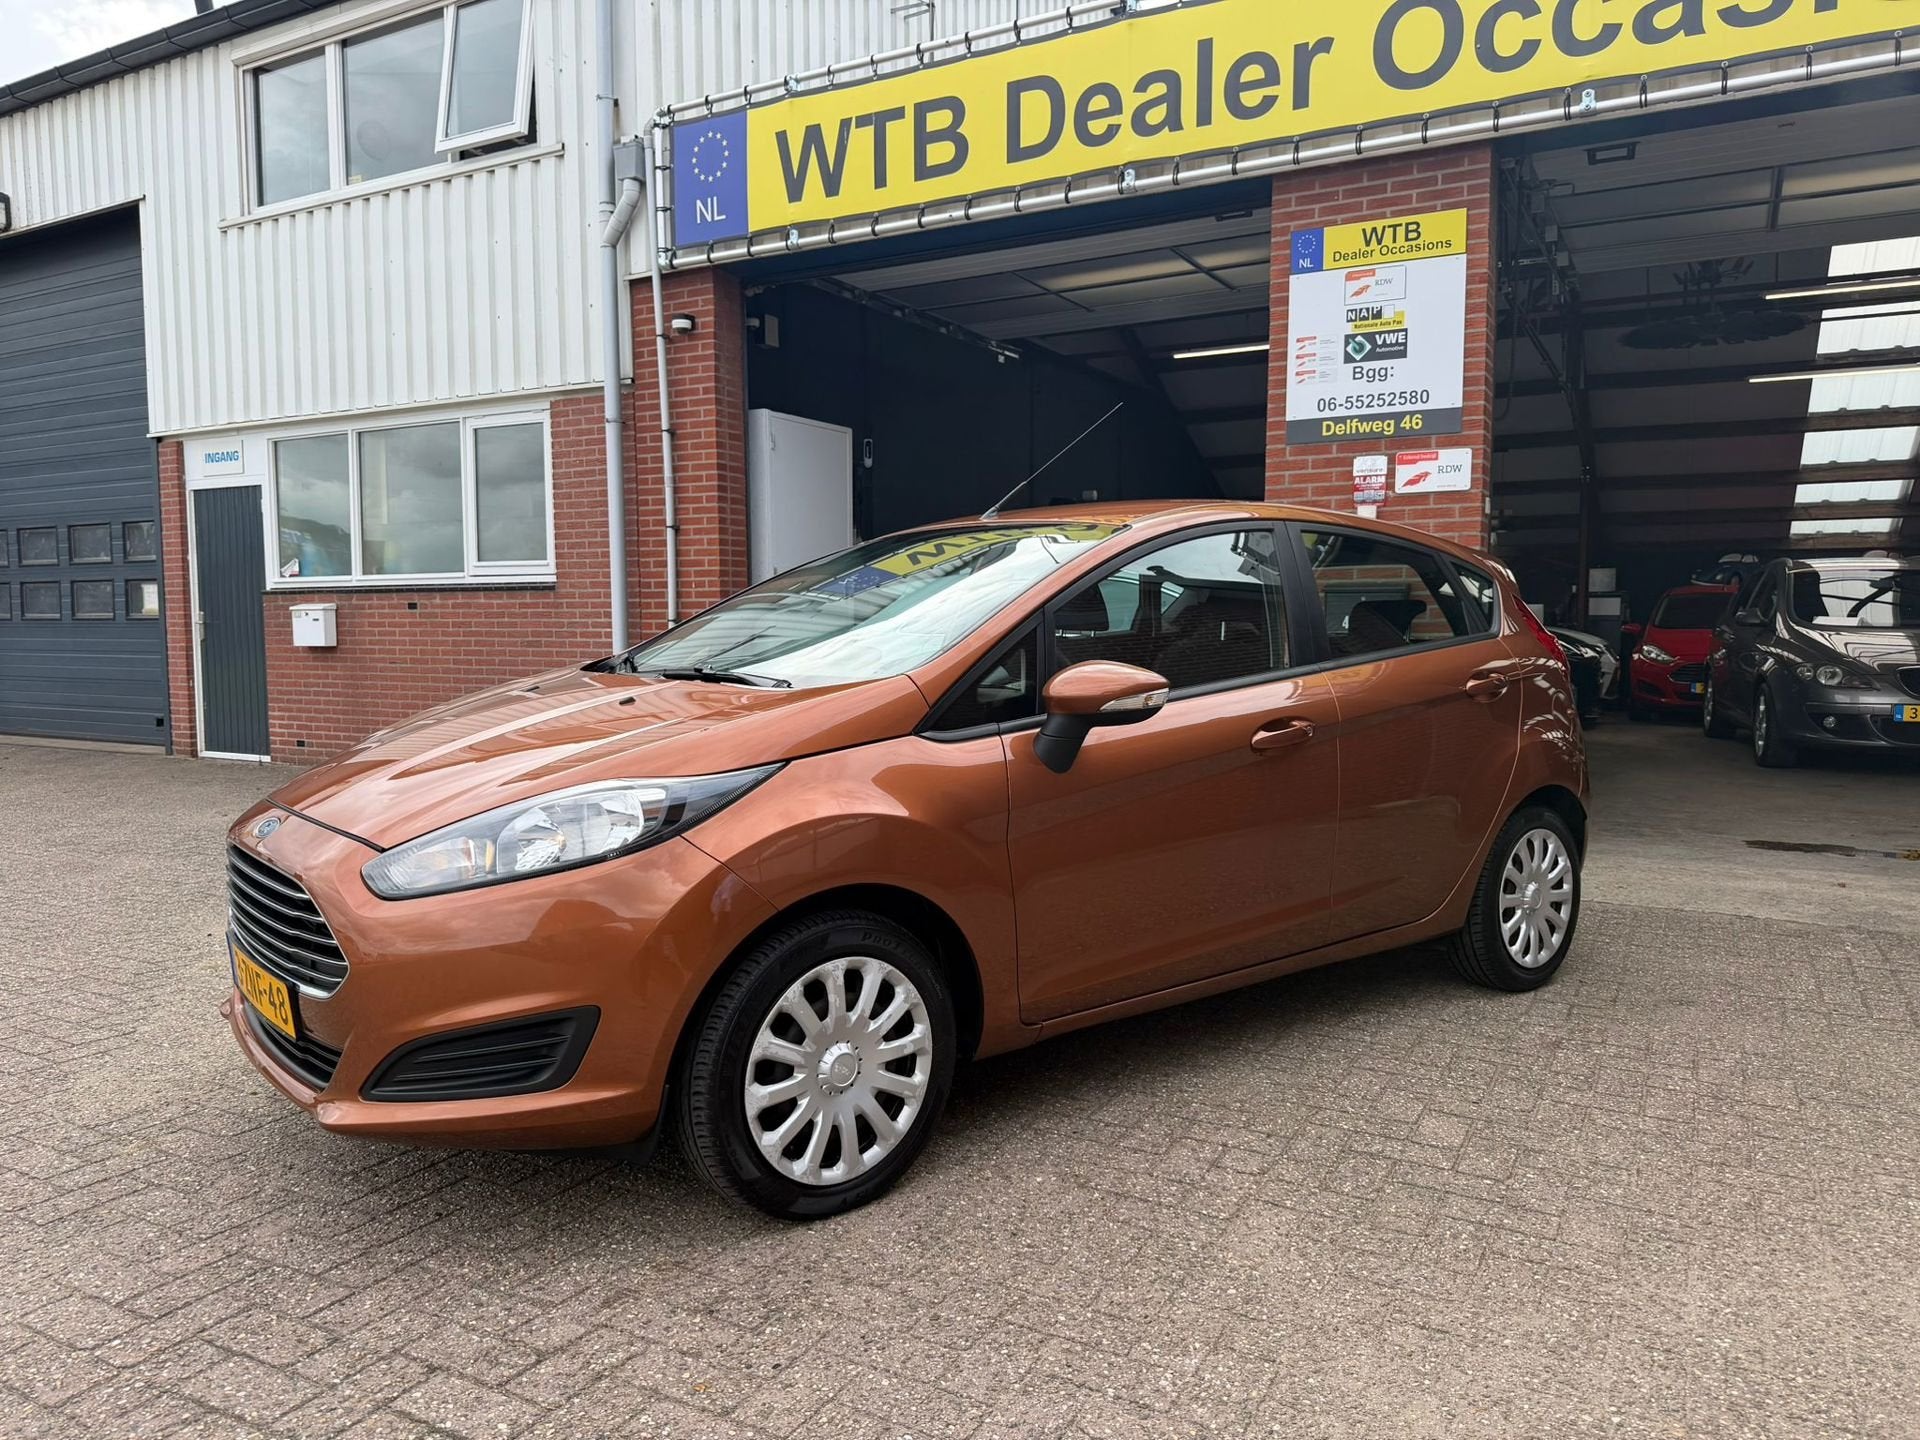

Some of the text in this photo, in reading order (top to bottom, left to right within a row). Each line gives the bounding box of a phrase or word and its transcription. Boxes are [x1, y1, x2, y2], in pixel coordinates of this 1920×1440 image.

[775, 95, 969, 204] WTB
[1006, 36, 1334, 165] Dealer
[695, 195, 726, 226] NL
[1362, 221, 1422, 247] WTB
[1332, 239, 1453, 263] Dealer Occasions
[1299, 258, 1314, 269] NL
[1375, 332, 1407, 345] VWE
[1352, 366, 1395, 383] Bgg:
[1317, 389, 1431, 413] 06-55252580
[1321, 413, 1423, 437] Delfweg 46
[204, 450, 240, 464] INGANG
[1437, 464, 1463, 474] RDW
[1354, 475, 1386, 485] ALARM
